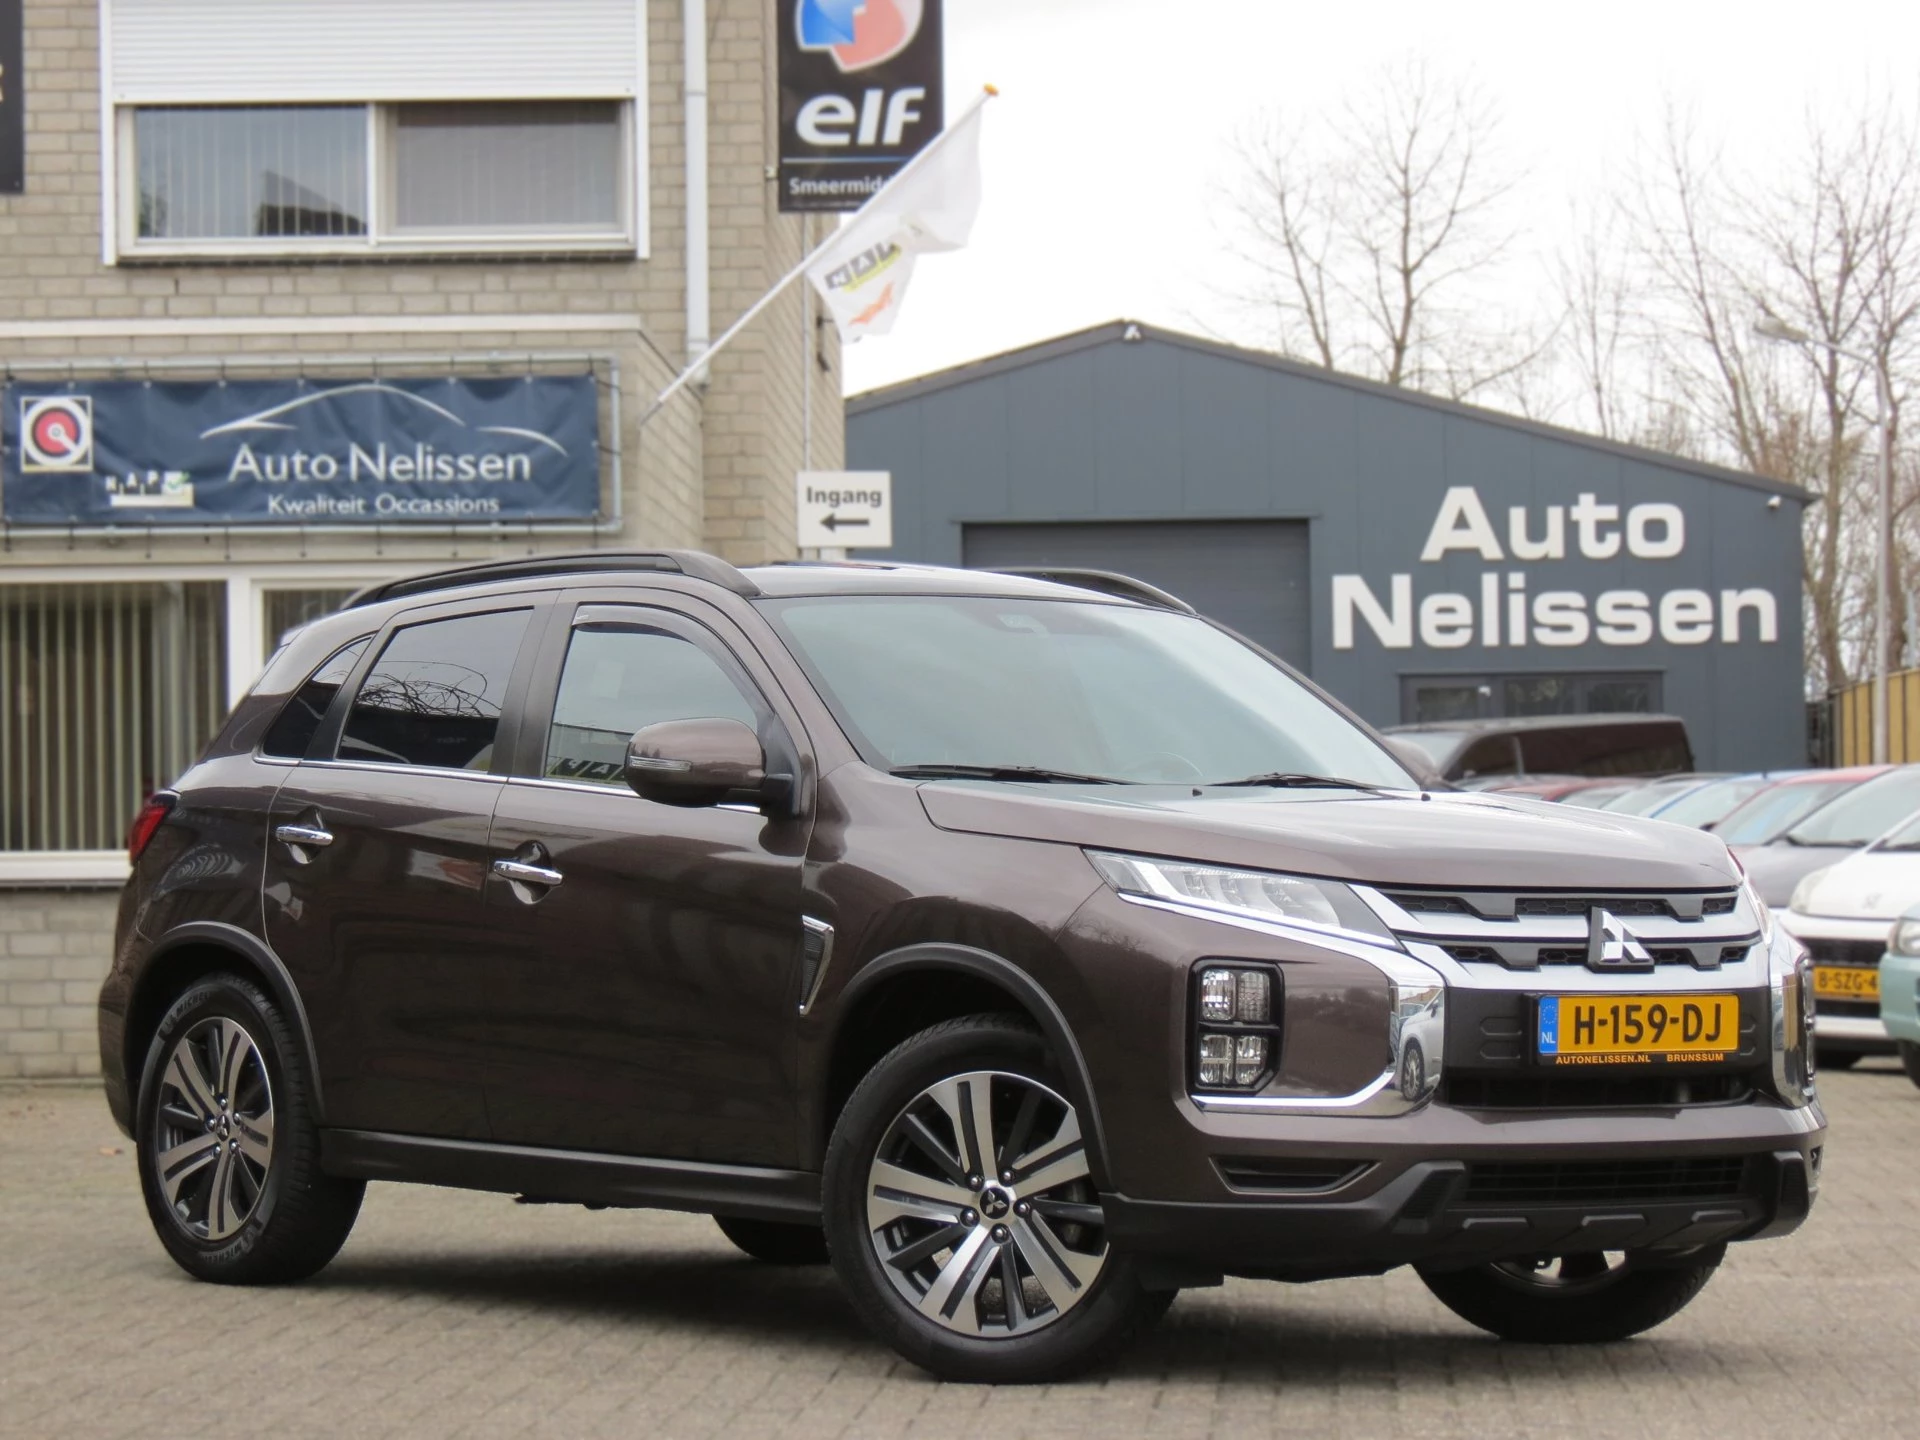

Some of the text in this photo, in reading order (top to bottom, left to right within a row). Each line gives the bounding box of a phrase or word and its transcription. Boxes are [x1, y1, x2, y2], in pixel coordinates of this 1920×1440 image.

[795, 86, 926, 146] elf
[788, 175, 886, 195] Smeermid
[228, 442, 531, 482] Auto Nelissen
[268, 492, 500, 515] Kwaliteit Occassions
[806, 485, 882, 509] Ingang
[1420, 486, 1685, 562] Auto
[1332, 572, 1778, 649] Nelissen
[1818, 971, 1878, 992] 8-SZG-4
[1541, 1003, 1722, 1045] NL H-159-DJ
[1556, 1052, 1724, 1065] AUTONELISSEN.NL BRUNSSUM
